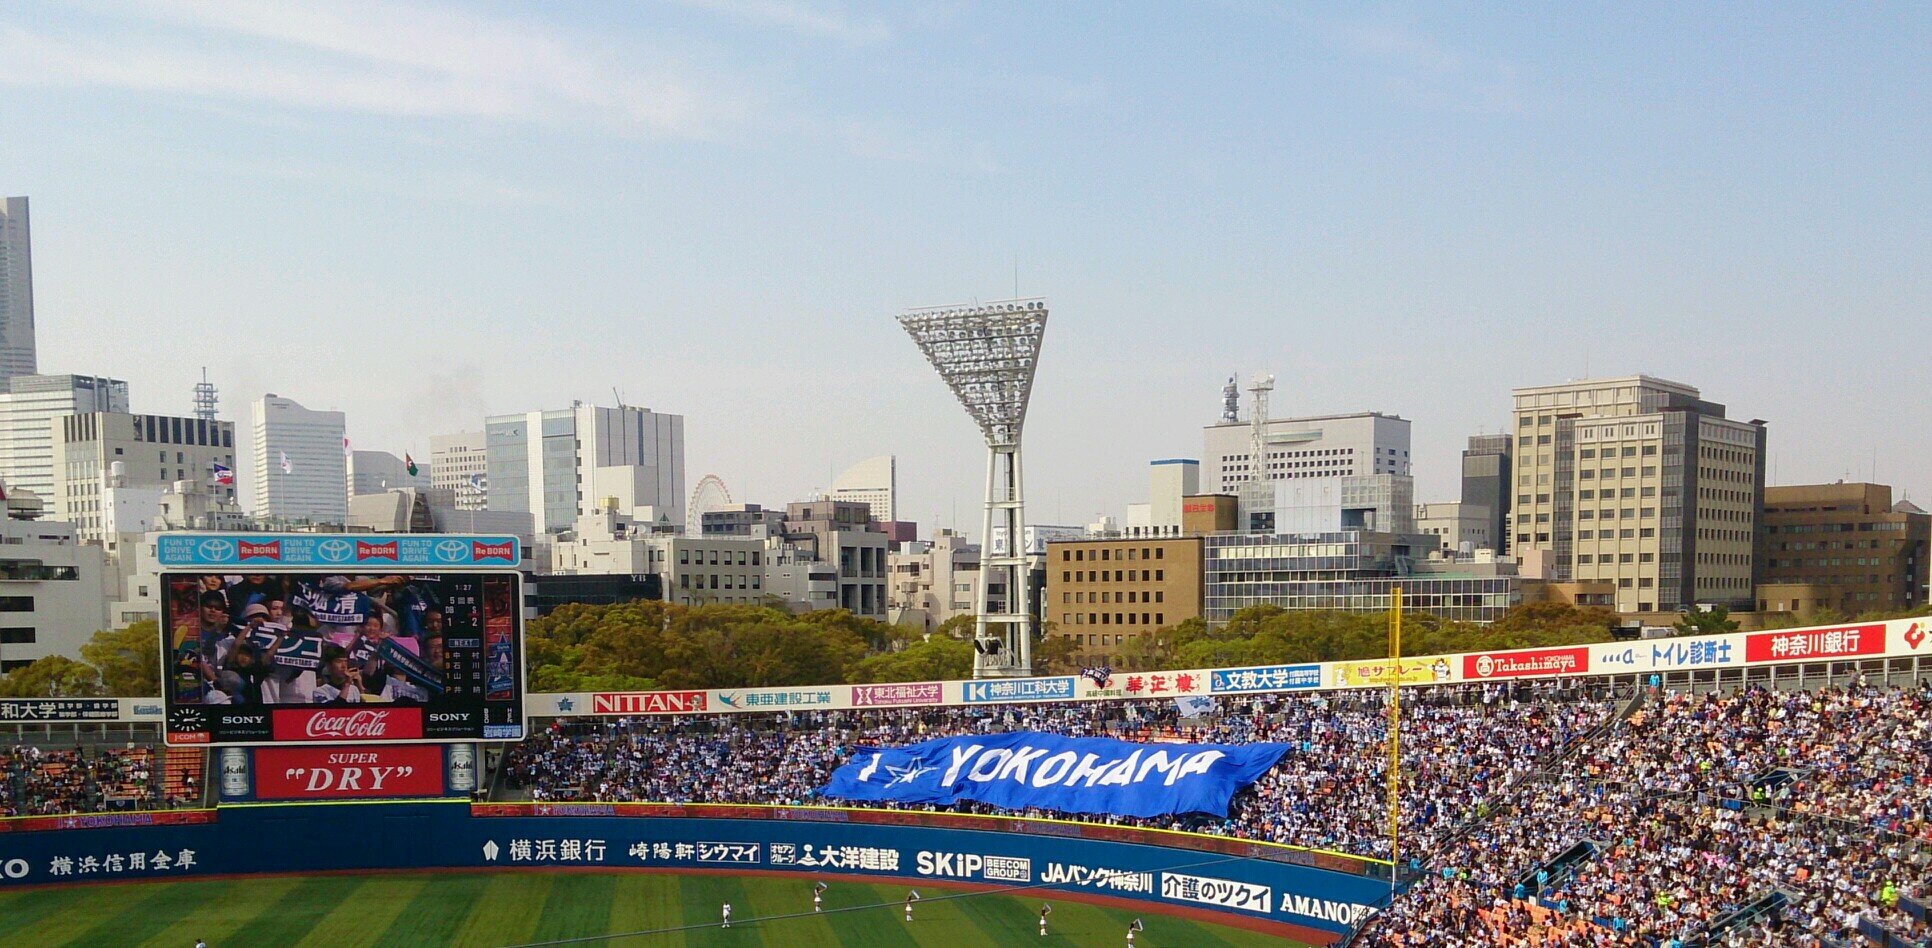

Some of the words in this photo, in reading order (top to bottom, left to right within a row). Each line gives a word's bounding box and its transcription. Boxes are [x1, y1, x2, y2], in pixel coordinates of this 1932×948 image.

[164, 539, 183, 547] FUN
[185, 539, 196, 547] TO
[284, 539, 301, 547] FUN
[303, 539, 315, 547] TO
[1771, 629, 1861, 658] 神奈川銀行
[1652, 638, 1732, 668] トイレ診断士
[1494, 656, 1576, 673] Takashimaya
[990, 679, 1070, 697] 神奈川工科大学
[1226, 668, 1289, 690] 文教大学
[746, 690, 831, 707] 東亜建設工業
[873, 684, 939, 699] 東北福祉大学
[593, 693, 684, 713] NITTAN
[222, 716, 265, 724] SONY
[429, 713, 471, 721] SONY
[327, 752, 378, 765] SUPER
[857, 752, 881, 782] I
[941, 744, 1226, 789] YOKOHAMA
[80, 813, 154, 829] YOKOHAMA
[509, 838, 607, 862] 横浜銀行
[698, 844, 758, 861] シウマイ
[819, 844, 900, 872] 大洋建設
[49, 848, 198, 876] 横浜信用金庫
[916, 850, 983, 878] SKiP
[987, 858, 1028, 870] BEECOM
[987, 867, 1020, 878] GROUP
[1040, 861, 1153, 895] JAバンク神奈川
[1163, 874, 1270, 911] 介護のツクイ
[1279, 892, 1351, 925] AMANO
